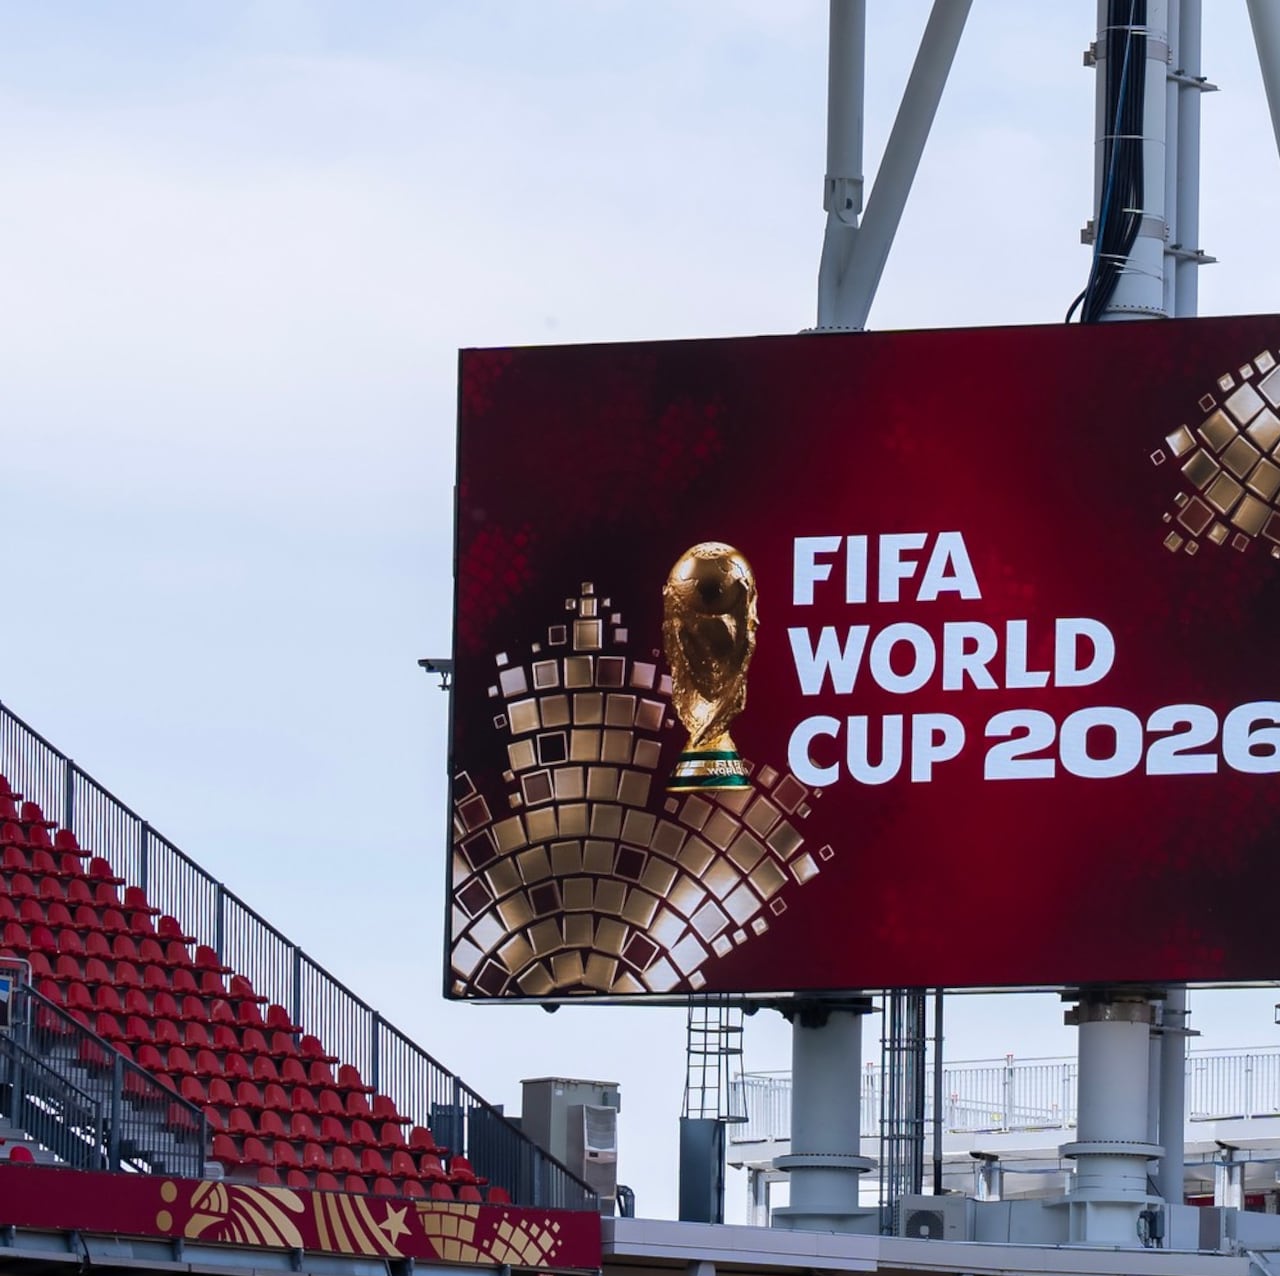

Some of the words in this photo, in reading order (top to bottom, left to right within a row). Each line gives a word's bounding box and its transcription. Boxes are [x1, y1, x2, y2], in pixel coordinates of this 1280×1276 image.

[793, 532, 982, 605] FIFA
[788, 618, 1115, 695] WORLD
[788, 713, 967, 787] CUP
